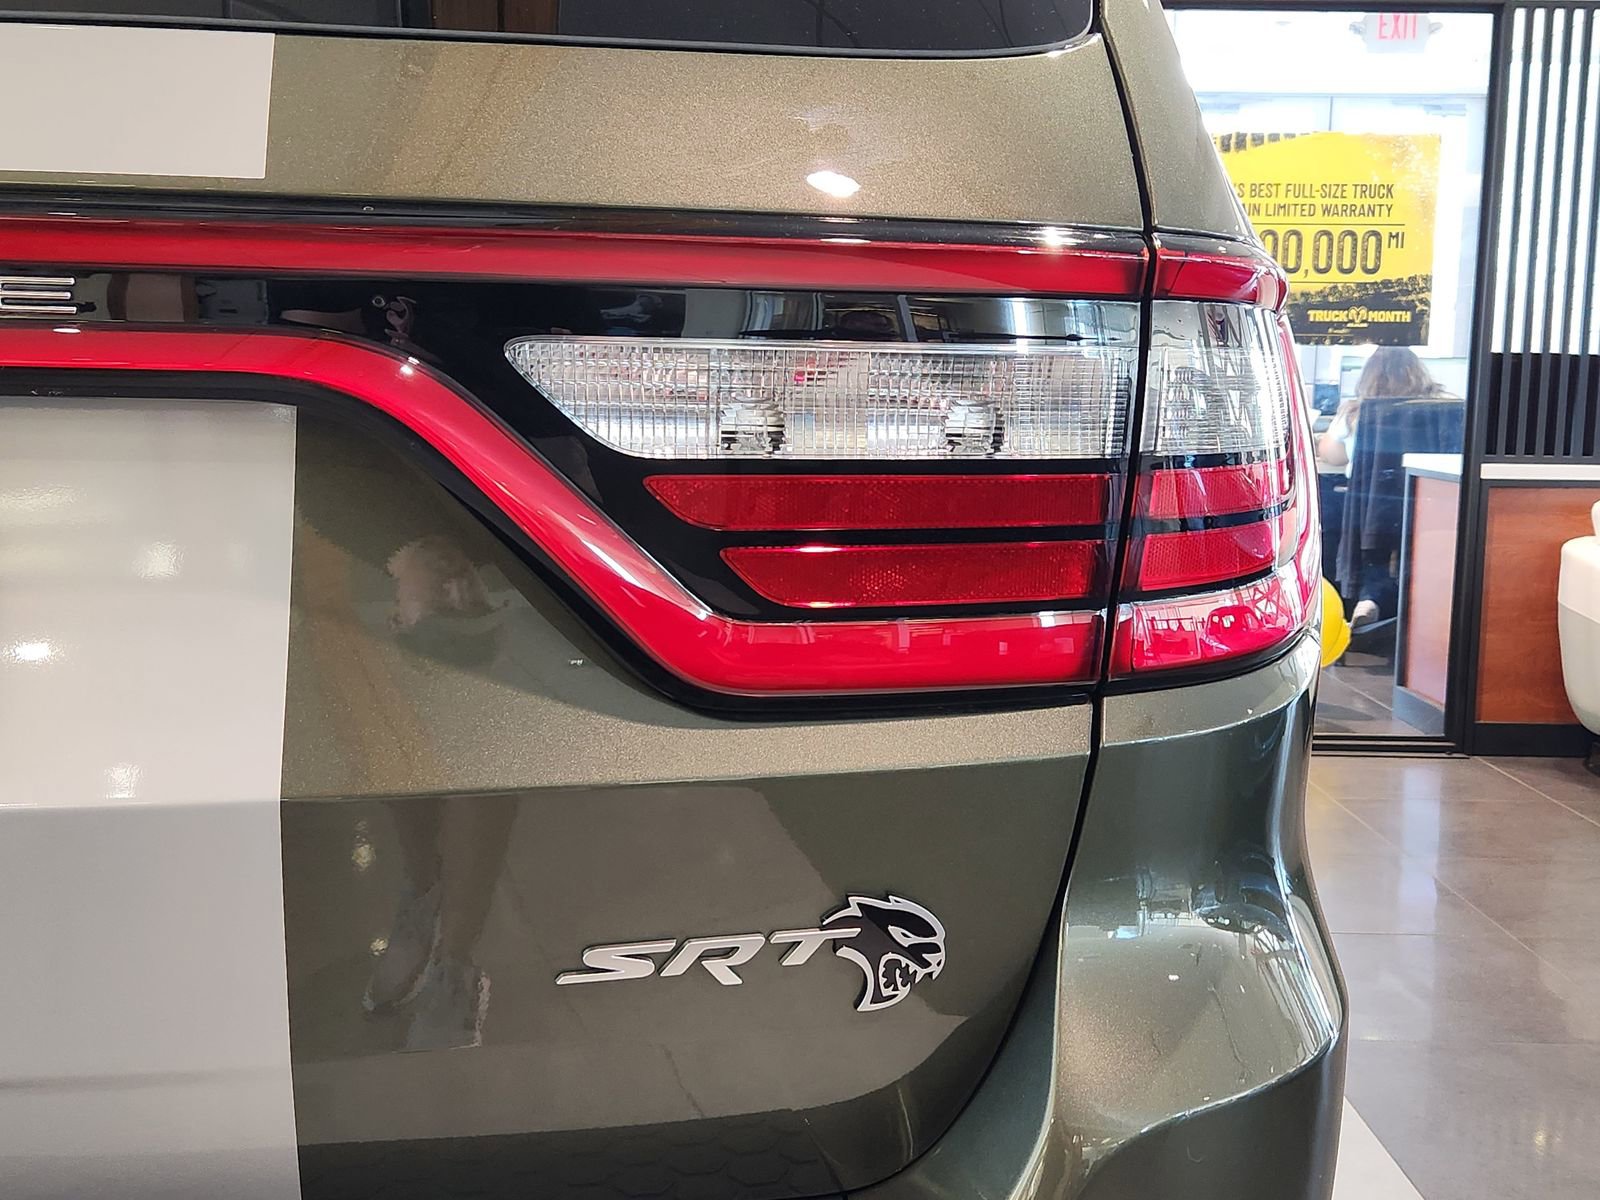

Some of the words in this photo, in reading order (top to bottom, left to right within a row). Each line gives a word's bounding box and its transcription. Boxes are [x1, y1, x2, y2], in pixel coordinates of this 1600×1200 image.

[1250, 183, 1281, 198] BEST
[1285, 183, 1348, 199] FULL-SIZE
[1352, 183, 1394, 199] TRUCK
[1265, 203, 1316, 217] LIMITED
[1321, 203, 1393, 217] WARRANTY
[1387, 231, 1405, 249] MI
[1307, 309, 1348, 322] TRUCK
[1367, 310, 1412, 323] MONTH
[555, 927, 861, 986] SRT
